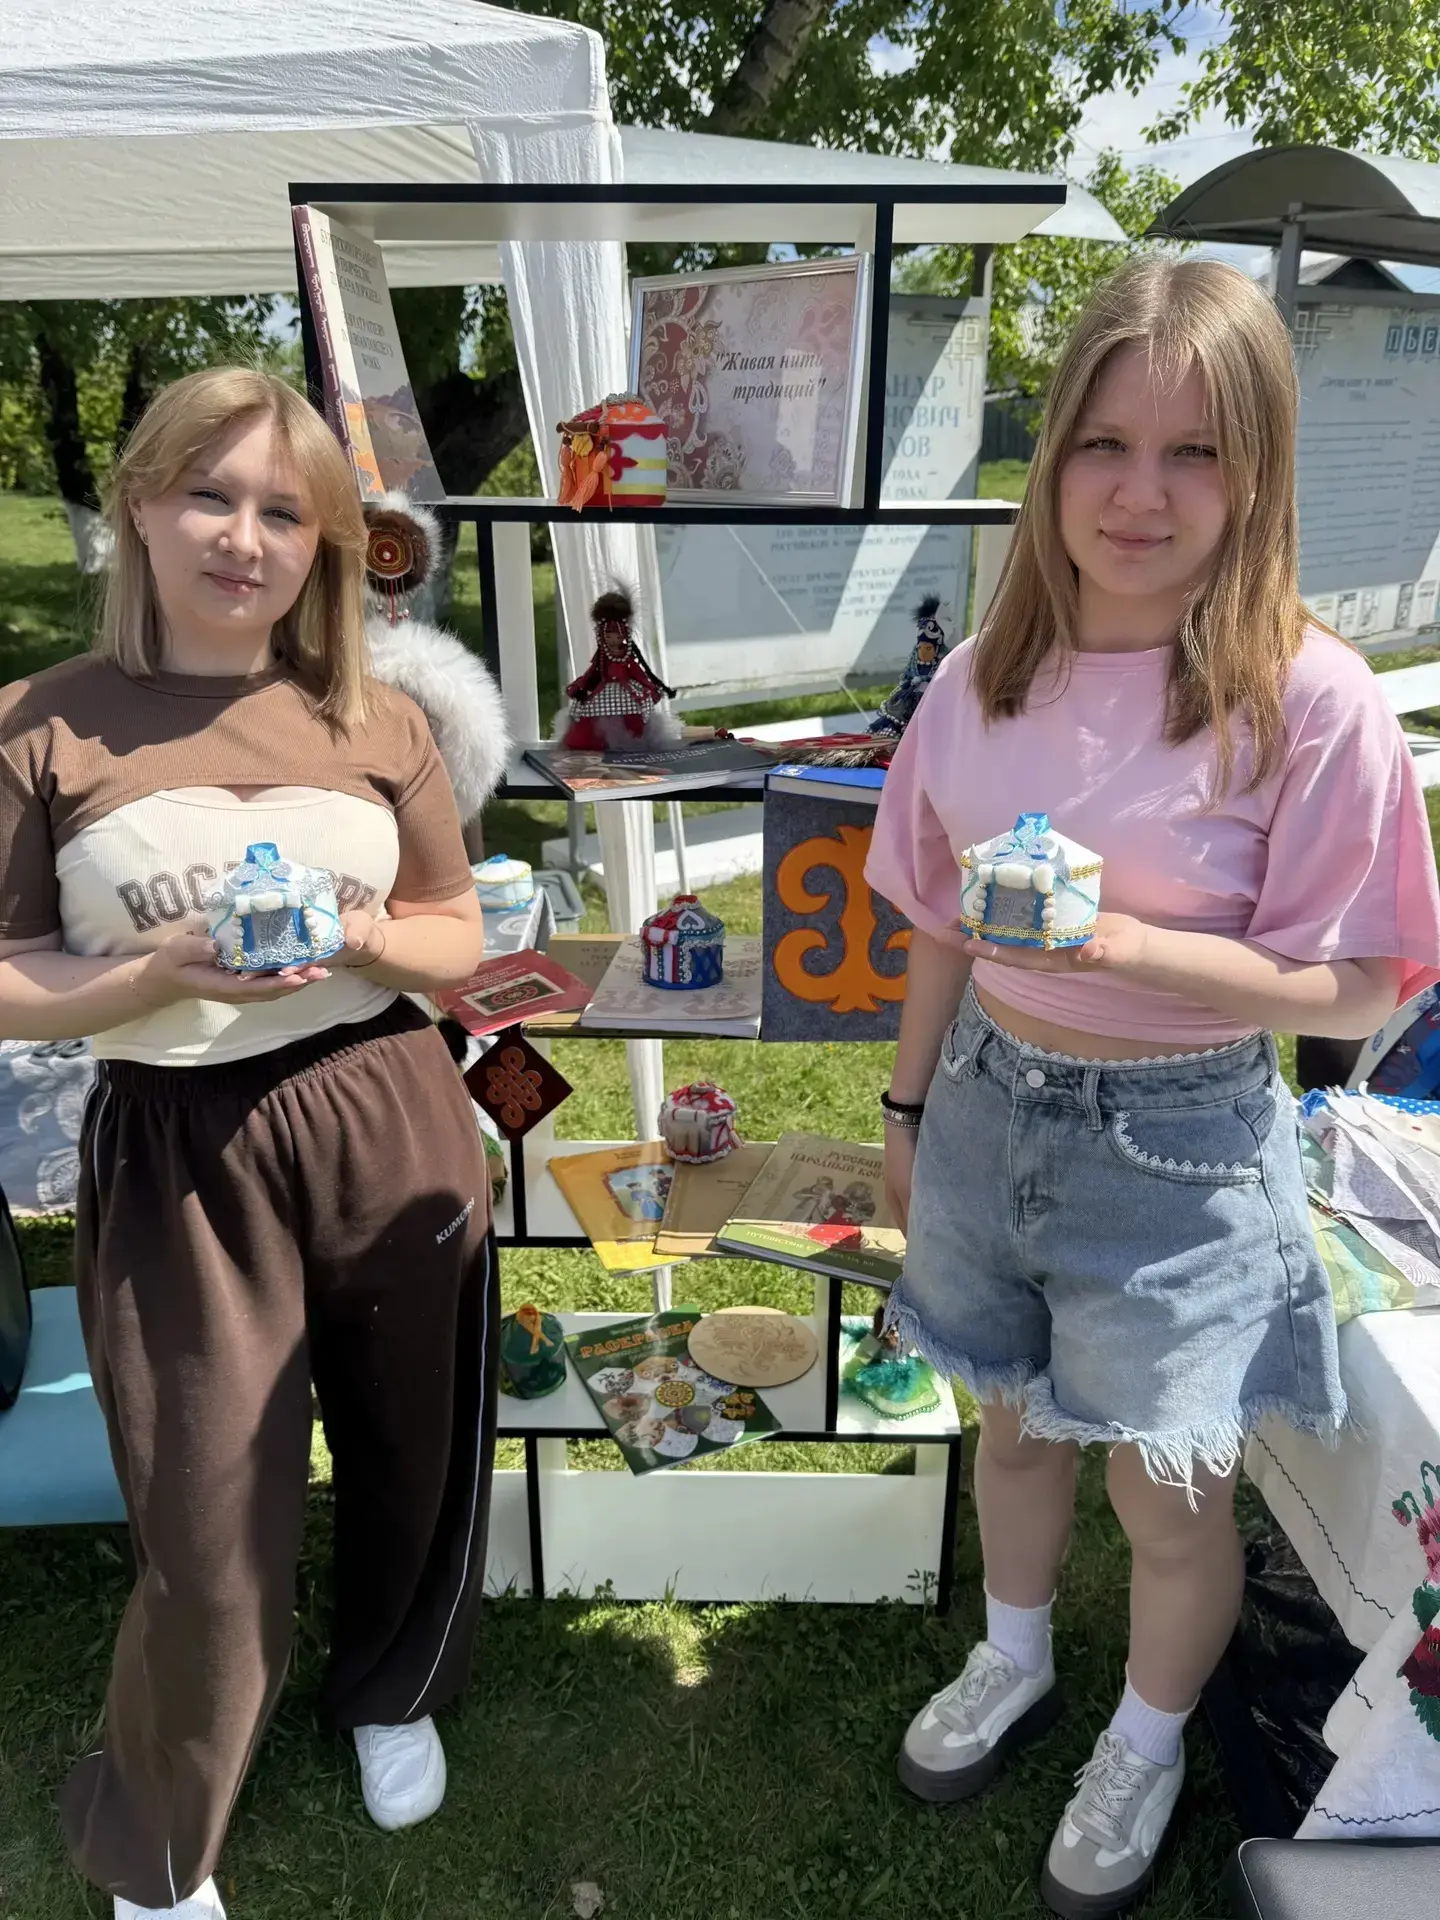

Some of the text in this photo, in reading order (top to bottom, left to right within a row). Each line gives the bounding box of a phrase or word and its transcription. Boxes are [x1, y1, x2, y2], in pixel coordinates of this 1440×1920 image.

[1386, 328, 1439, 352] ПЬЕ
[716, 352, 776, 371] "Живая
[732, 377, 827, 404] традиций"
